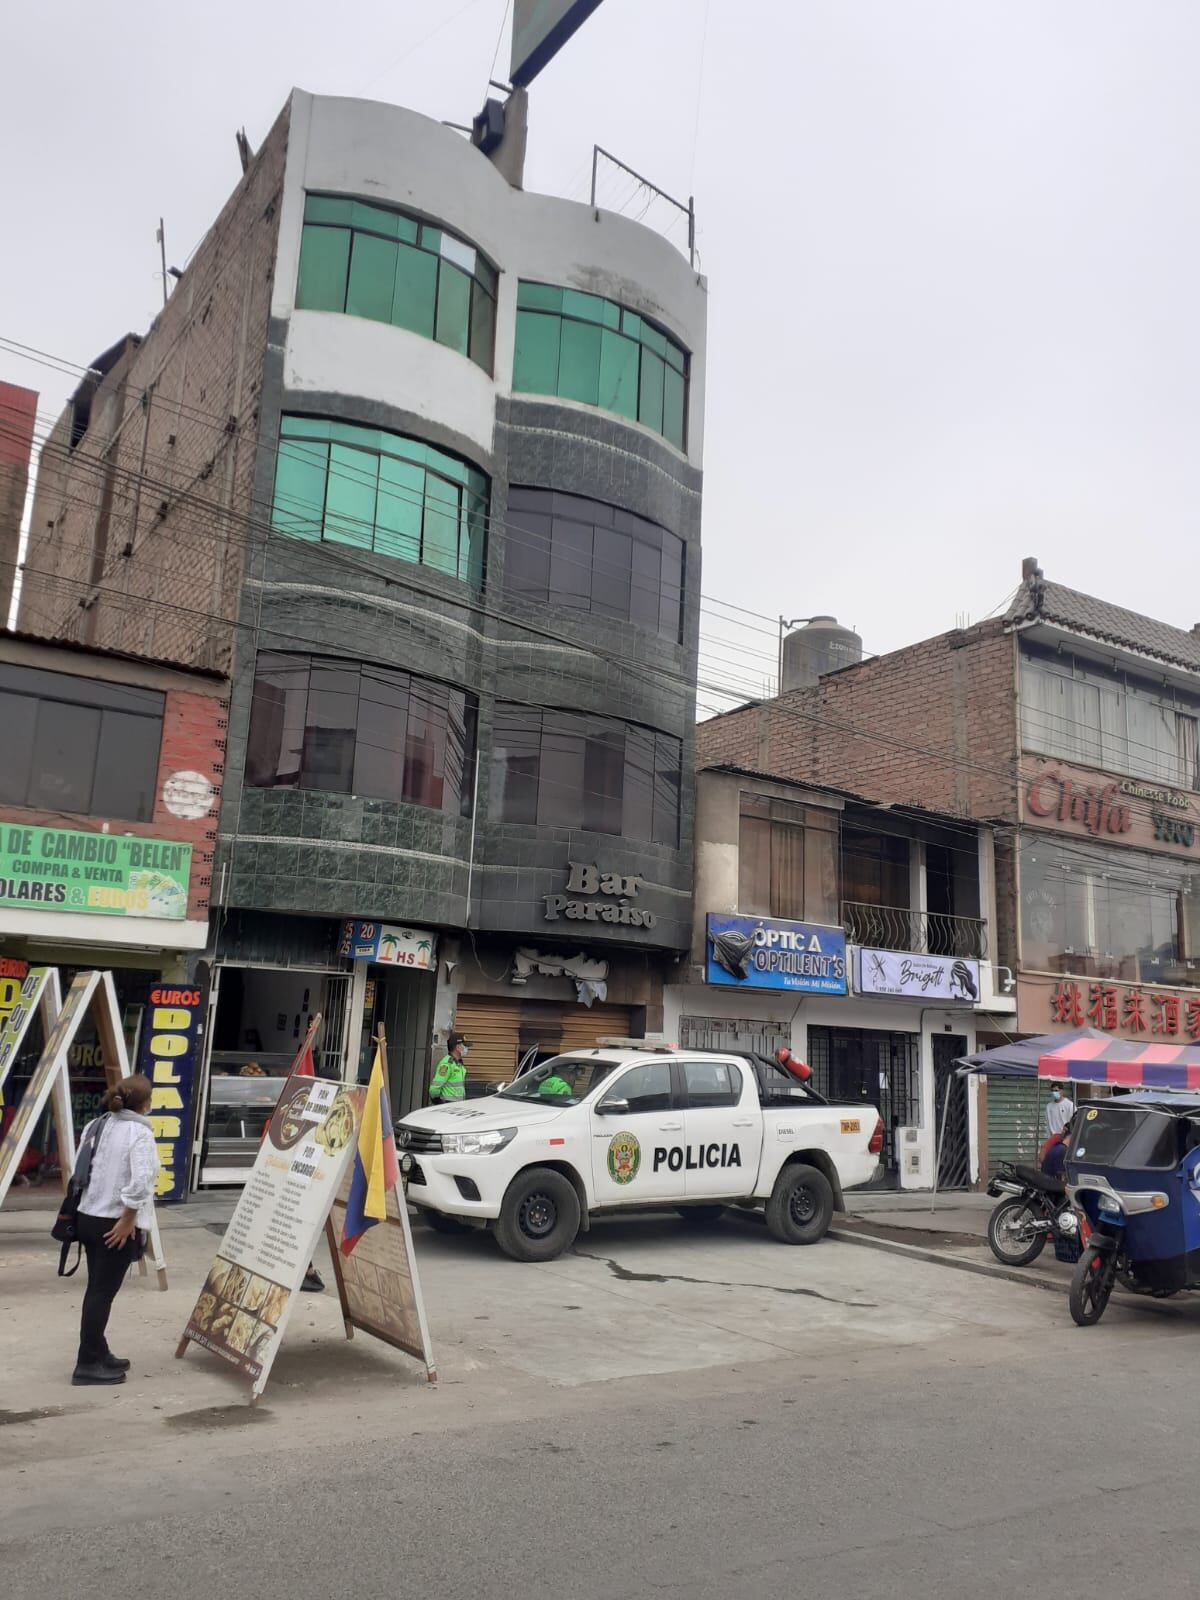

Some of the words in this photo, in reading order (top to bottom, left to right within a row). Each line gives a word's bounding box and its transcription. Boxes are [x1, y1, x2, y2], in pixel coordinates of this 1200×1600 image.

[8, 829, 33, 855] DE
[41, 832, 117, 865] CAMBIO
[12, 860, 68, 878] COMPRA
[71, 867, 81, 878] &
[84, 867, 122, 883] VENTA
[566, 861, 643, 897] Bar
[70, 886, 84, 904] &
[360, 923, 375, 940] 20
[653, 1143, 742, 1172] POLICIA
